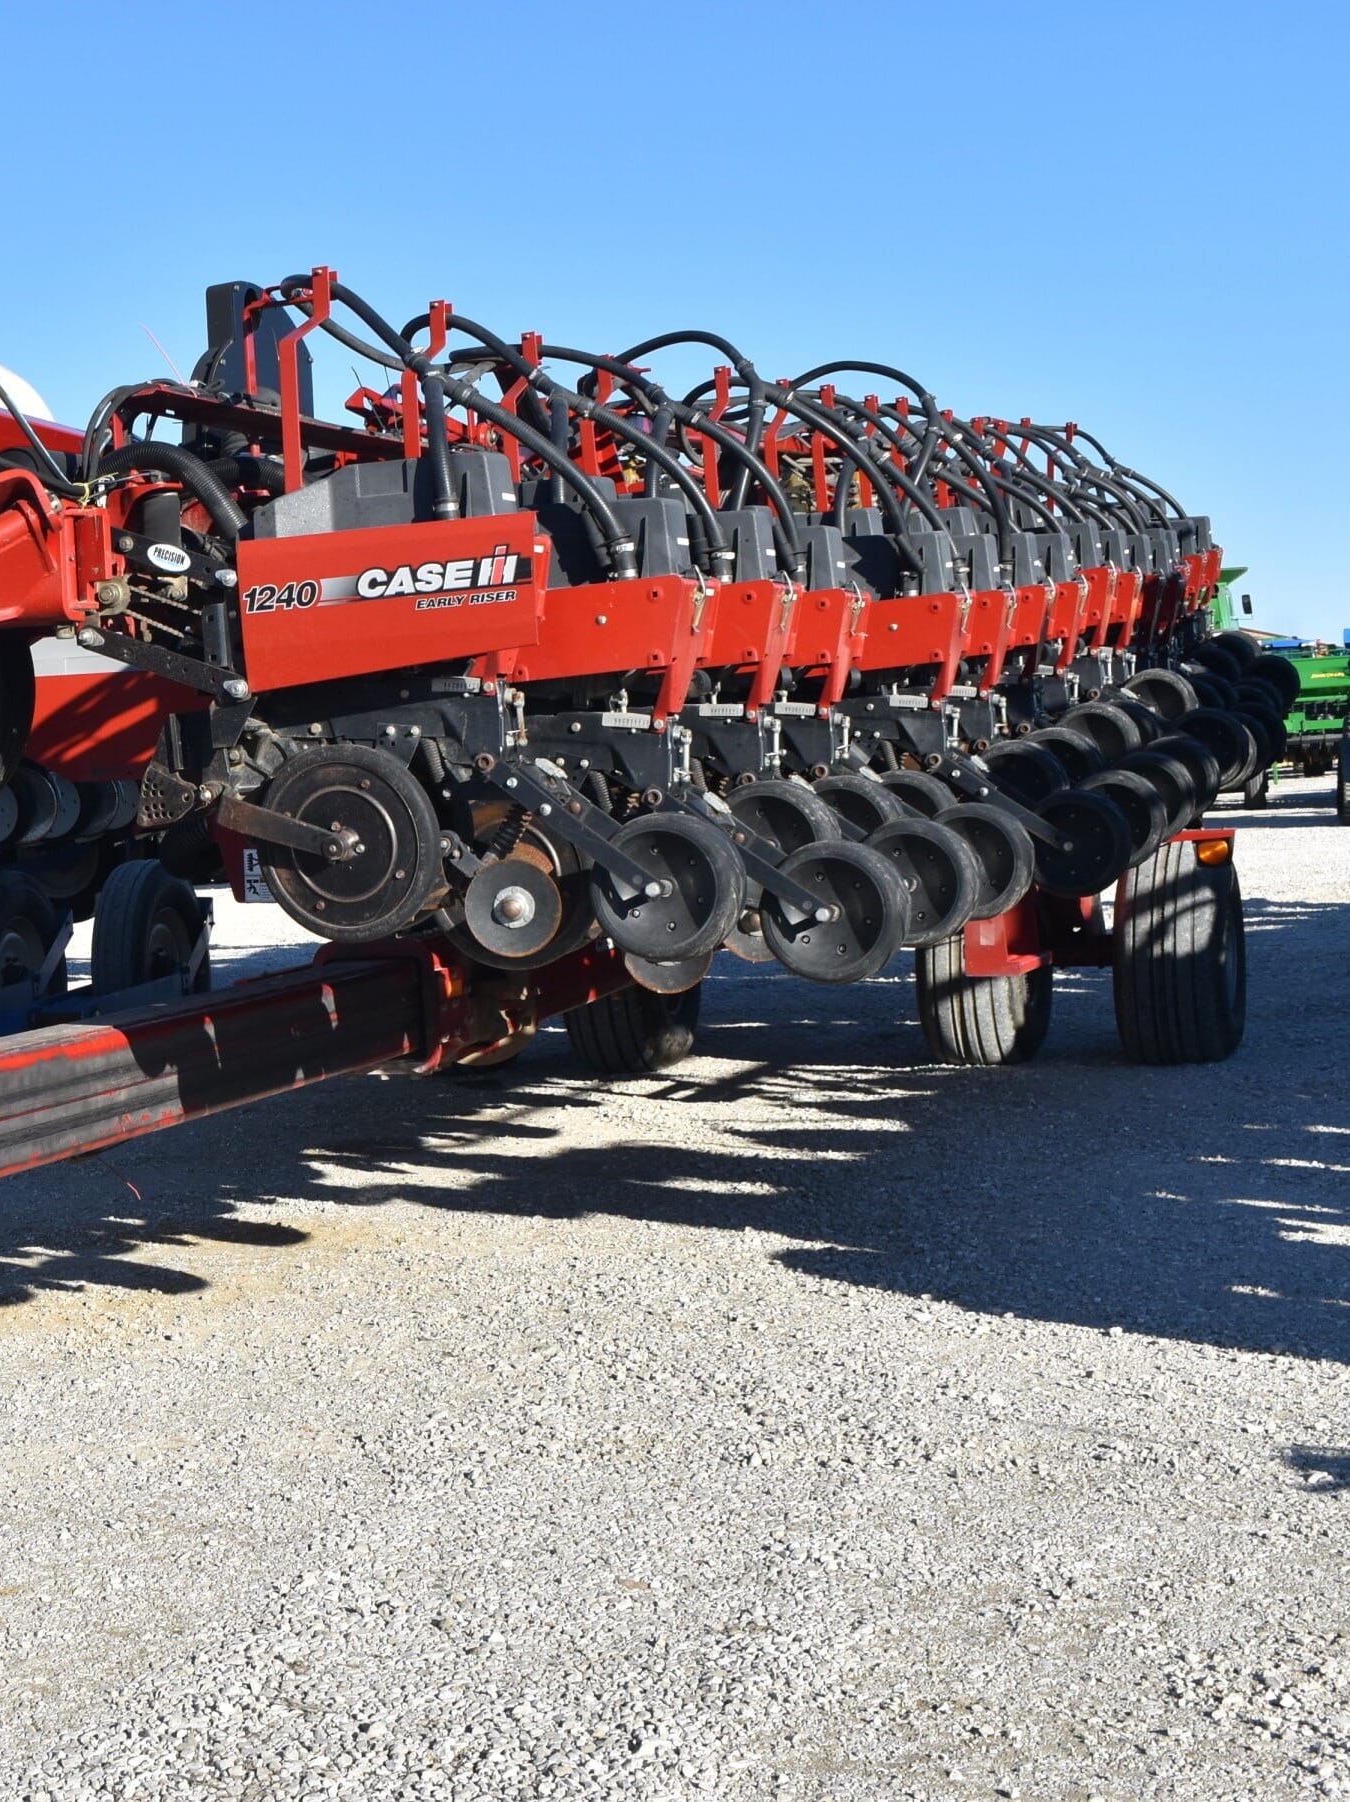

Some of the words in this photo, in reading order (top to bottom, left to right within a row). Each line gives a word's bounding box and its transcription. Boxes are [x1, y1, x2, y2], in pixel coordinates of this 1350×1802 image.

[153, 546, 186, 566] PRECISION
[356, 559, 476, 599] CASE
[242, 578, 318, 613] 1240
[415, 594, 466, 611] EARLY
[468, 590, 517, 607] RISER
